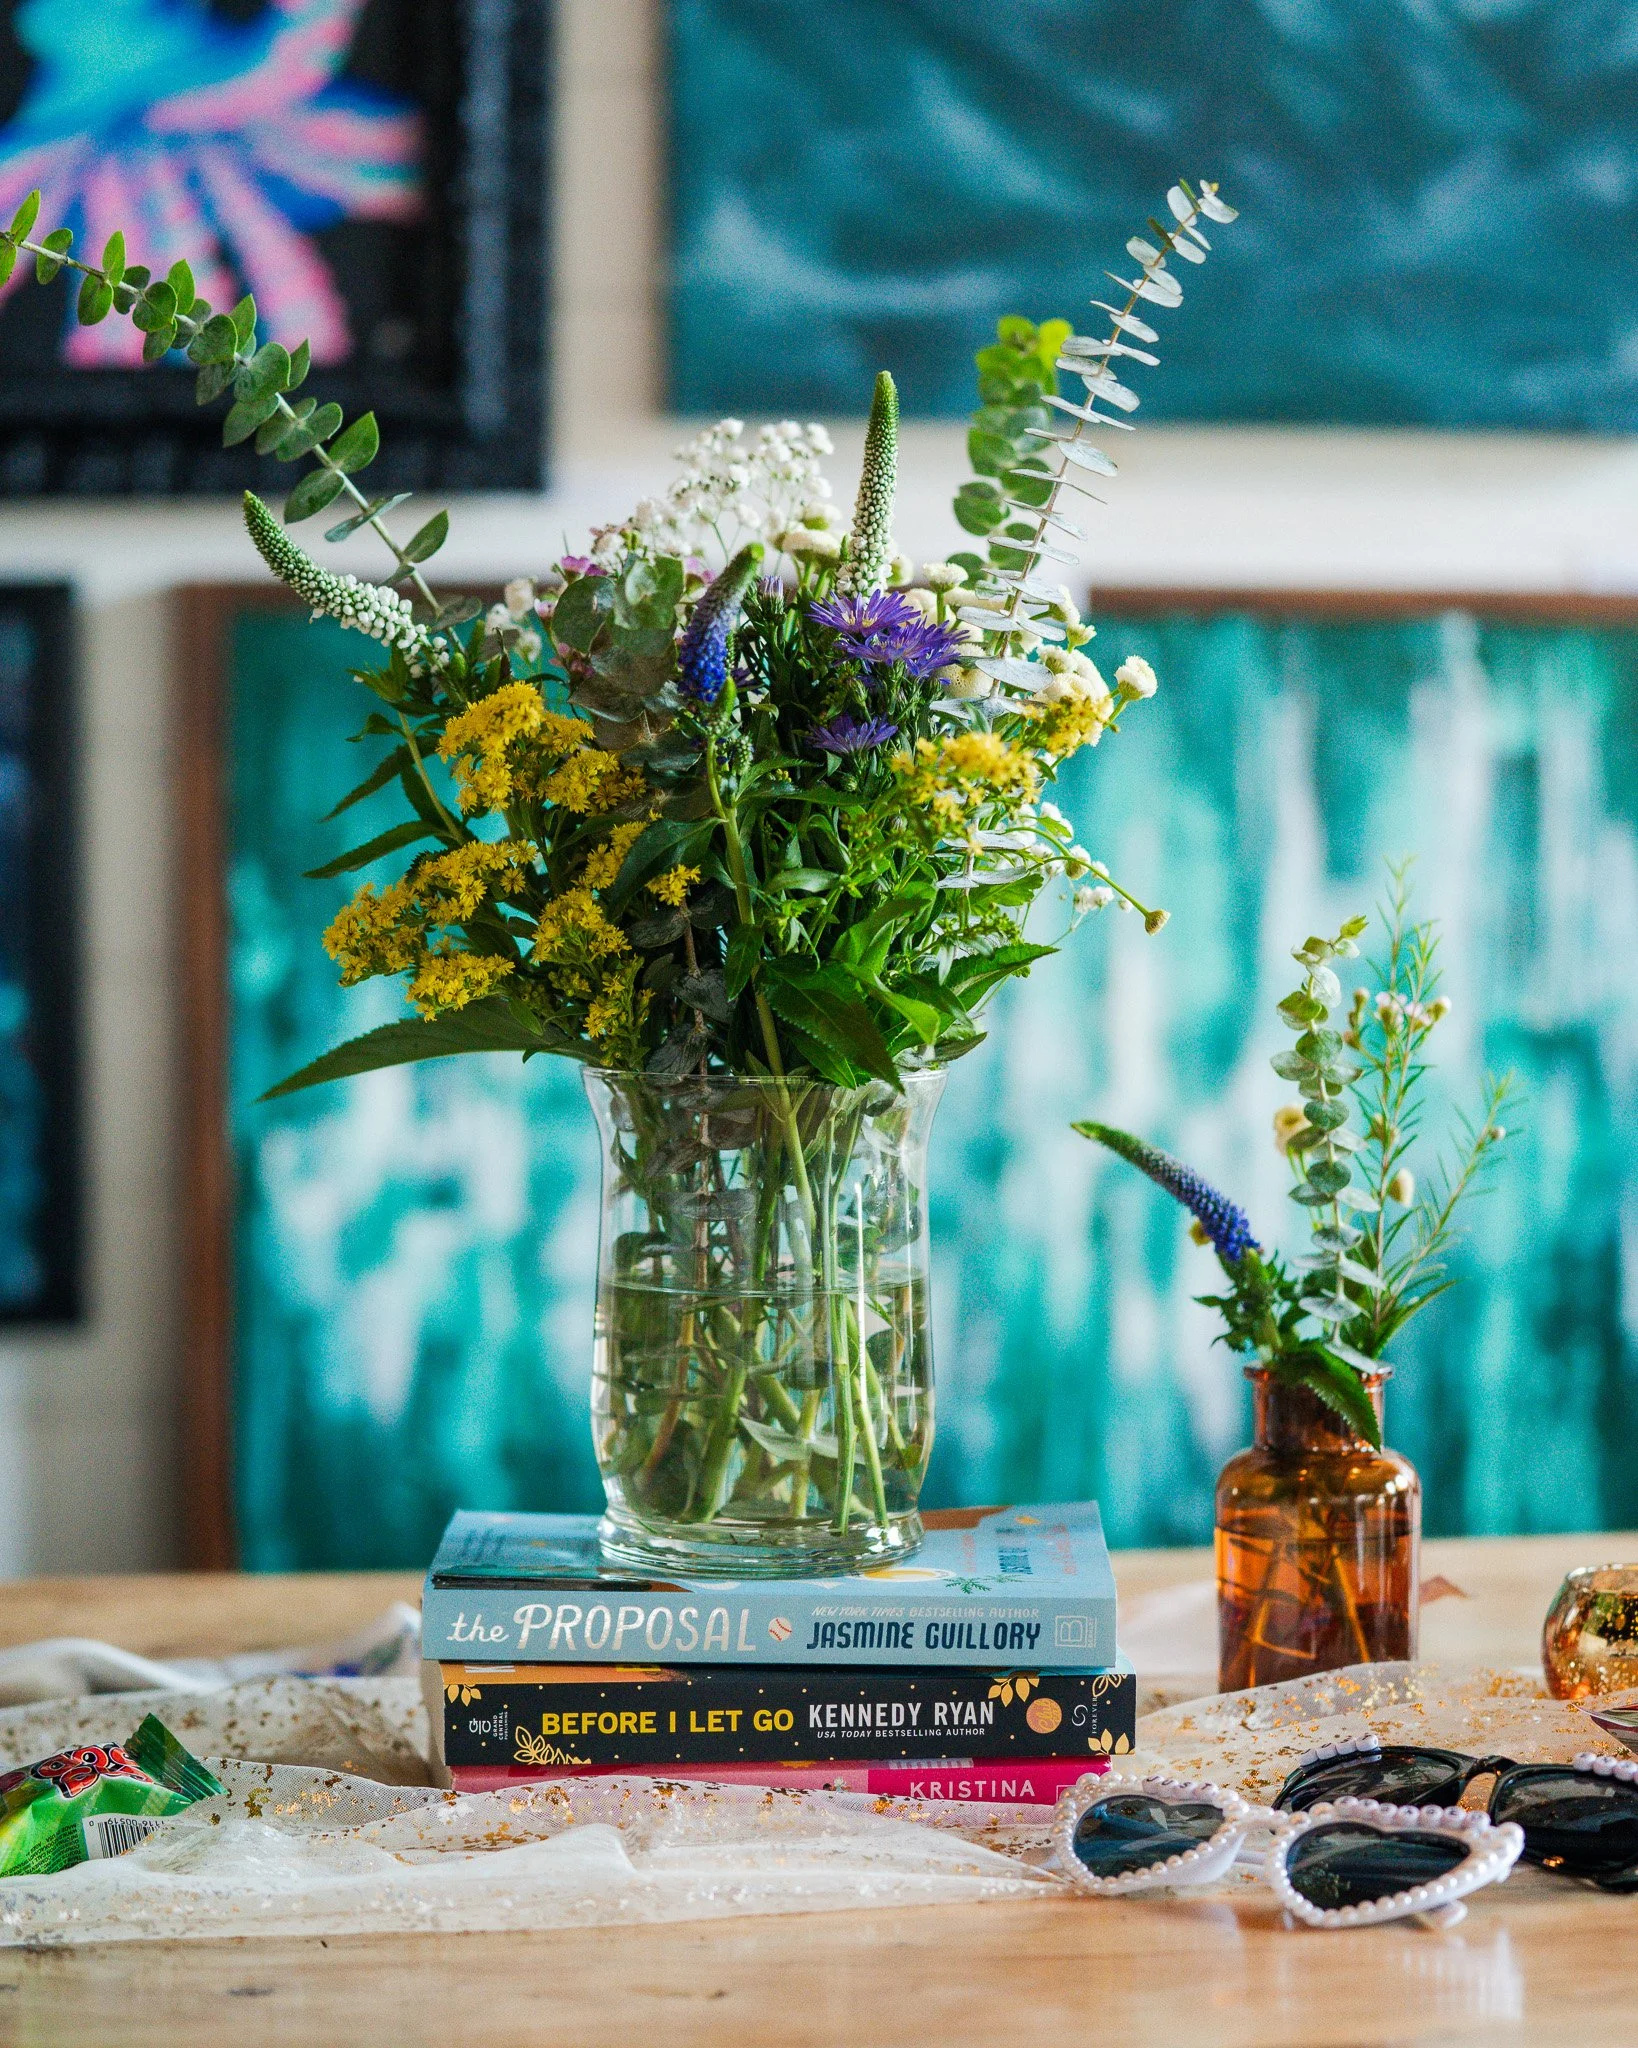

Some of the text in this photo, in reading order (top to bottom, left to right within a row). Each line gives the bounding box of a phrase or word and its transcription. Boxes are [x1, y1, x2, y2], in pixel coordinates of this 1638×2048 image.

[811, 1606, 1040, 1618] NEW YORK TIMES BESTSELLING AUTHOR
[446, 1604, 757, 1652] the PROPOSAL
[806, 1621, 1041, 1650] JASMINE GUILLORY
[541, 1708, 794, 1736] BEFORE I LET GO
[808, 1701, 995, 1729] KENNEDY RYAN
[816, 1727, 986, 1739] USA TODAY BESTSELLING AUTHOR
[909, 1779, 1036, 1799] KRISTINA
